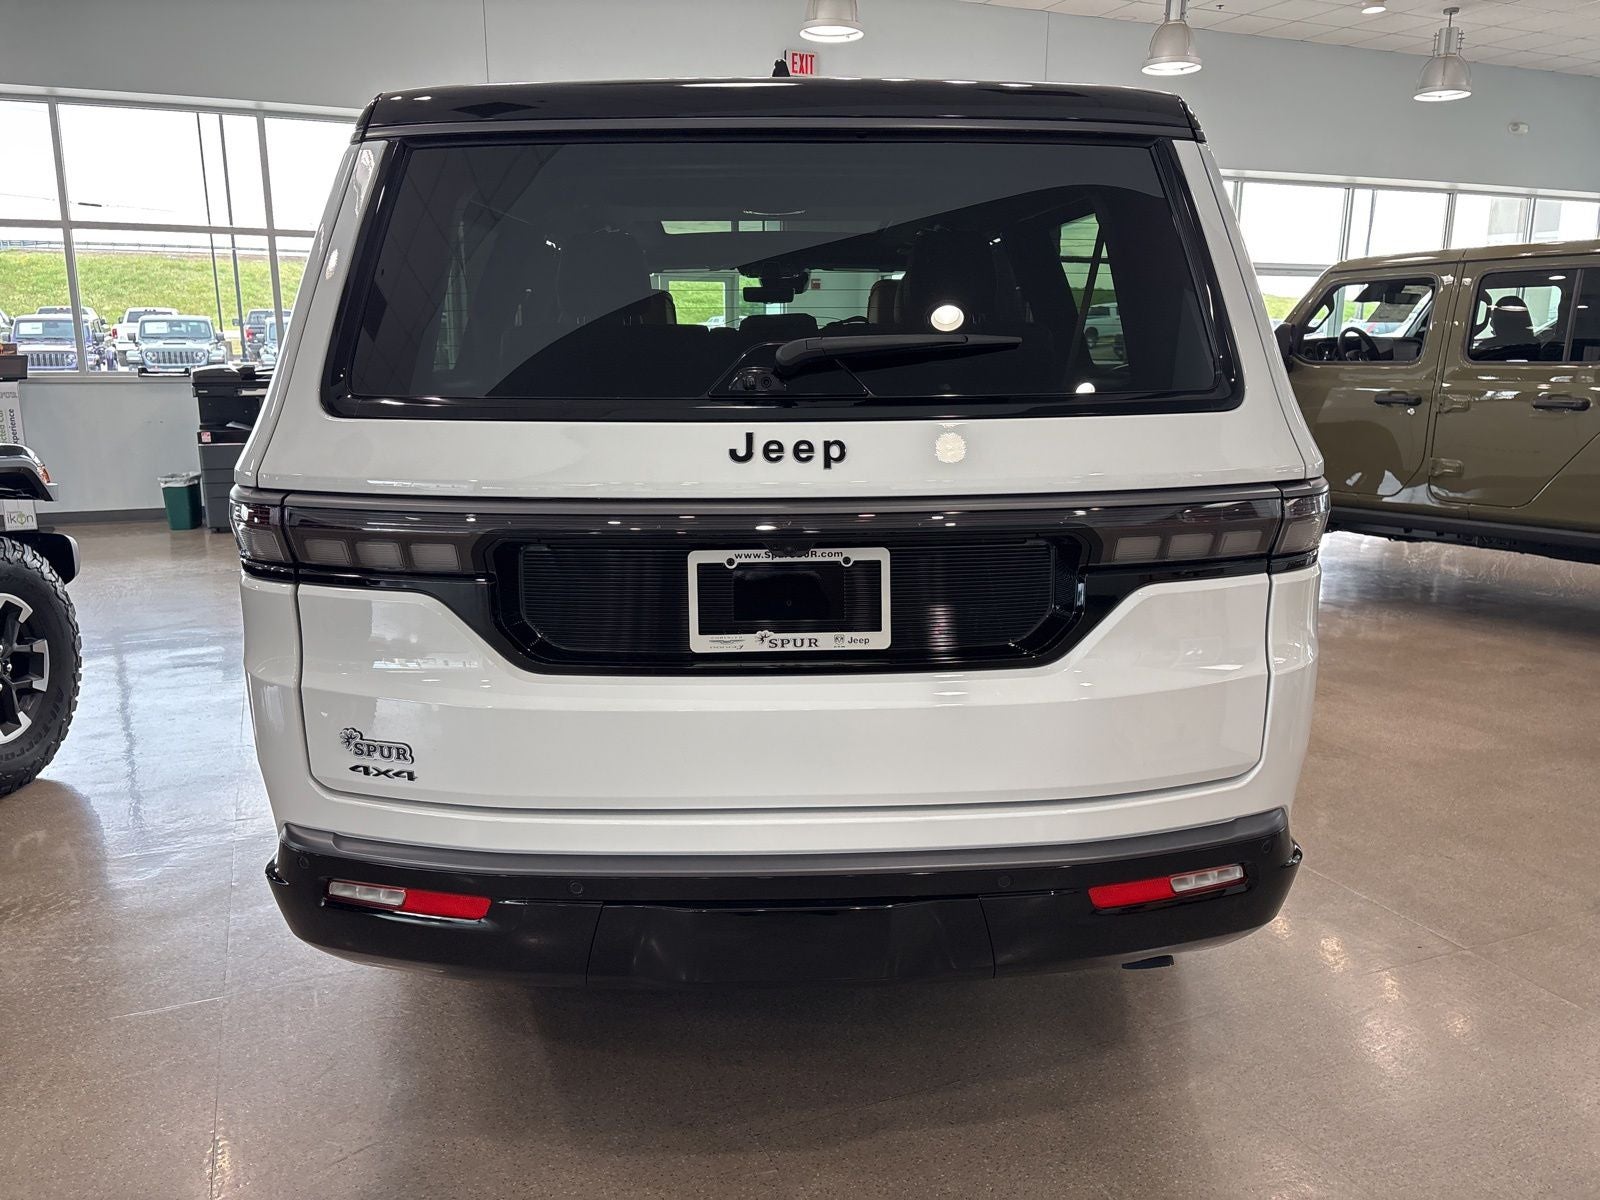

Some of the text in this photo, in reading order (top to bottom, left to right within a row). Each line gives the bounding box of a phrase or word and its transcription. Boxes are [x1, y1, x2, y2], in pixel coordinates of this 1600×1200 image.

[791, 52, 815, 75] EXIT
[8, 408, 19, 444] xperience
[728, 431, 846, 470] Jeep
[768, 637, 819, 649] SPUR
[847, 636, 870, 645] Jeep
[353, 742, 409, 761] SPUR
